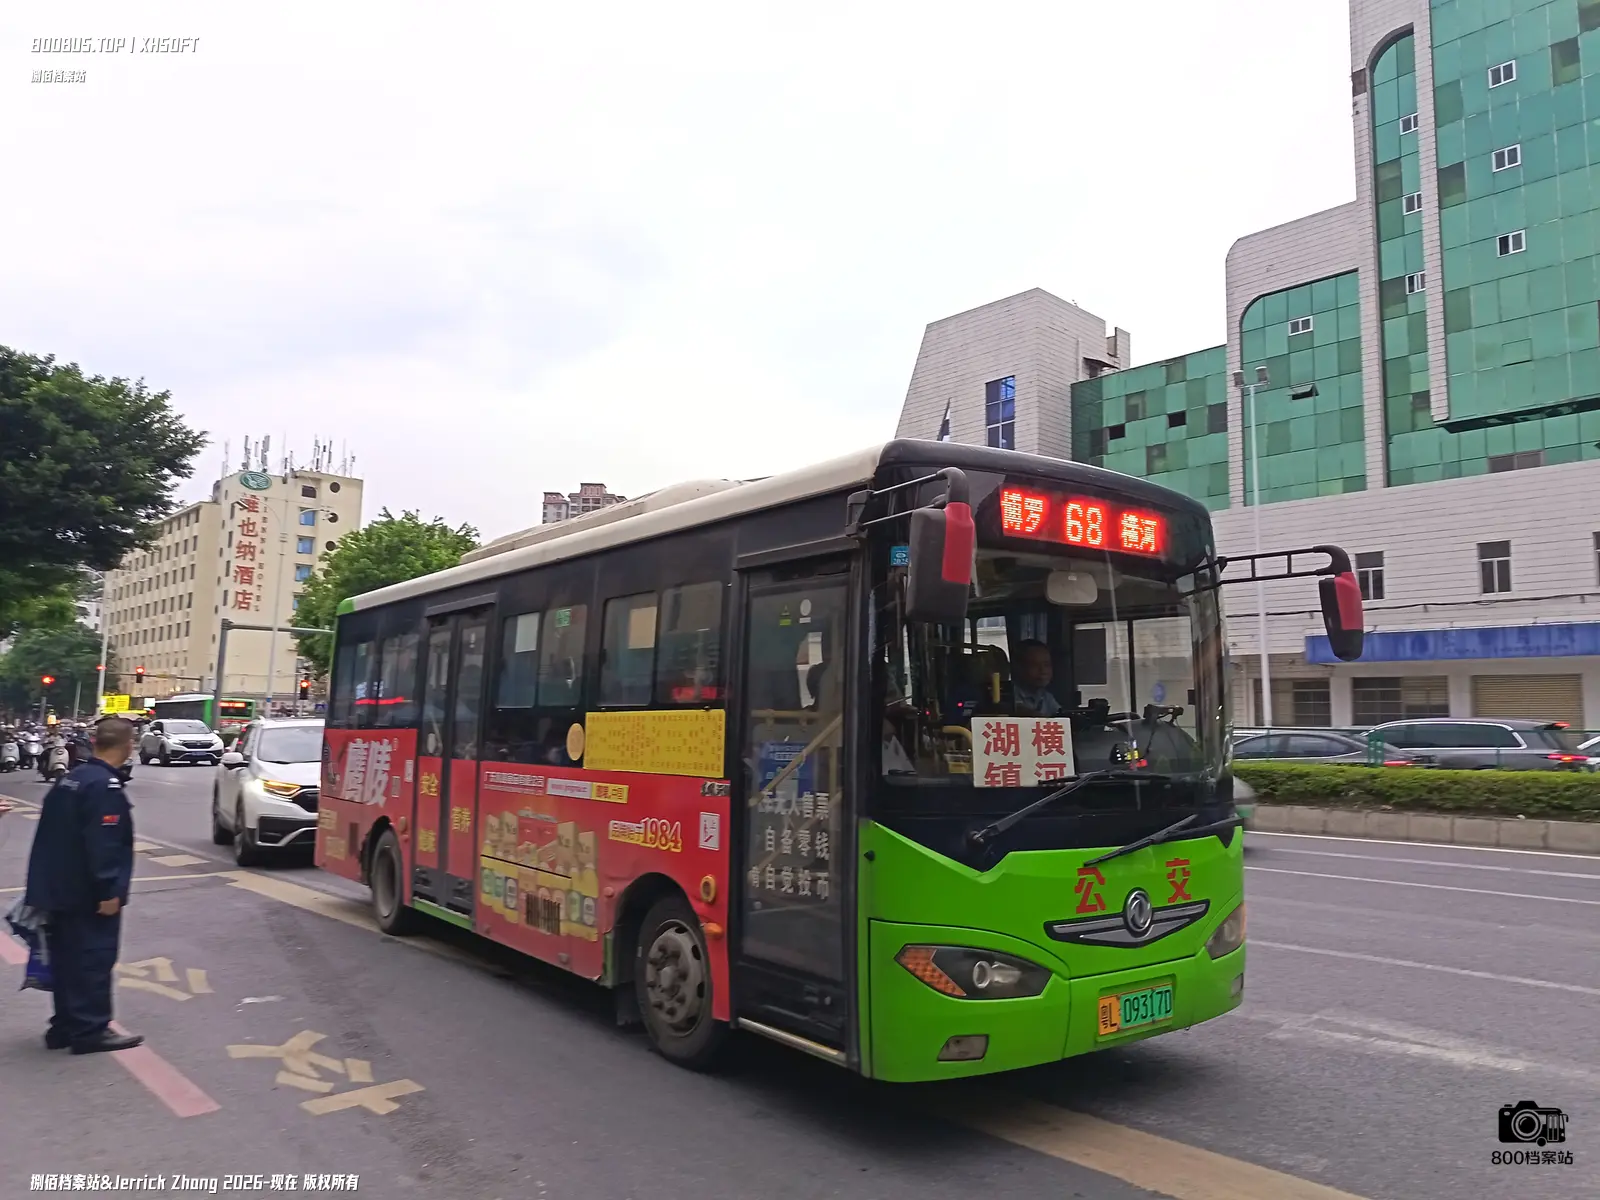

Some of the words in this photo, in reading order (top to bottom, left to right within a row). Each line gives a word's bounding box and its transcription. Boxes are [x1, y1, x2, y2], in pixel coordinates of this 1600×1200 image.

[1001, 491, 1043, 532] 博罗
[1066, 503, 1102, 545] 68
[231, 494, 260, 611] 维也纳酒店
[765, 826, 830, 860] 自备零钱
